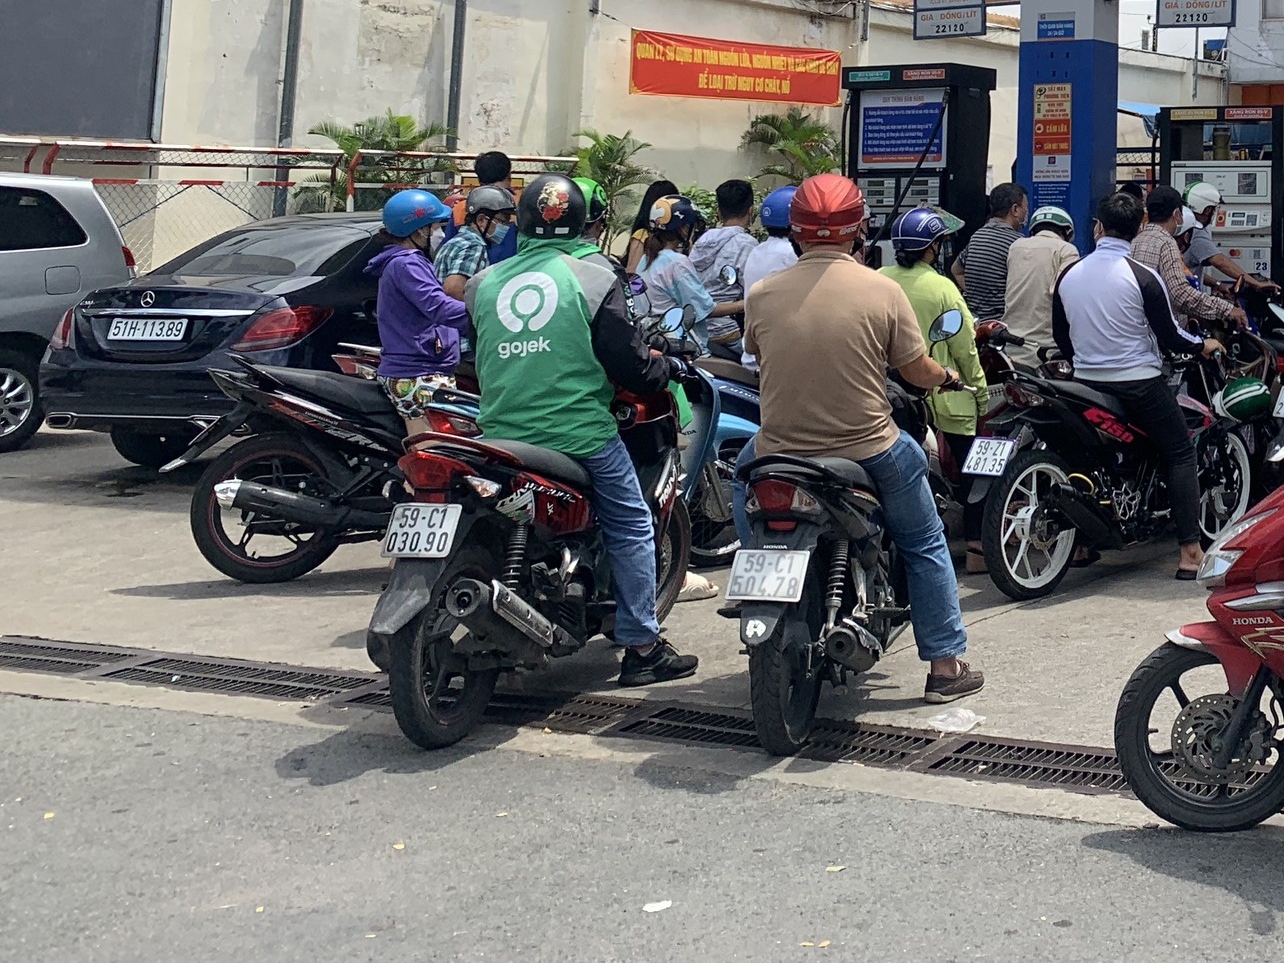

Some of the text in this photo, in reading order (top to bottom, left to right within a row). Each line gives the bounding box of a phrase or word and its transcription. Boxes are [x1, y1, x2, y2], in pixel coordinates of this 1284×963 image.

[1176, 13, 1208, 23] 22120
[935, 23, 964, 33] 22120
[1255, 262, 1268, 271] 23
[112, 320, 184, 338] 51H-113.89
[498, 336, 551, 359] gojek
[975, 440, 1006, 457] 59-Z1
[966, 457, 1005, 473] 481.35
[399, 508, 448, 528] 59-C1
[386, 531, 449, 552] 030.90
[744, 554, 794, 574] 59-C1
[732, 575, 798, 597] 504.78
[1232, 616, 1274, 625] HONDA
